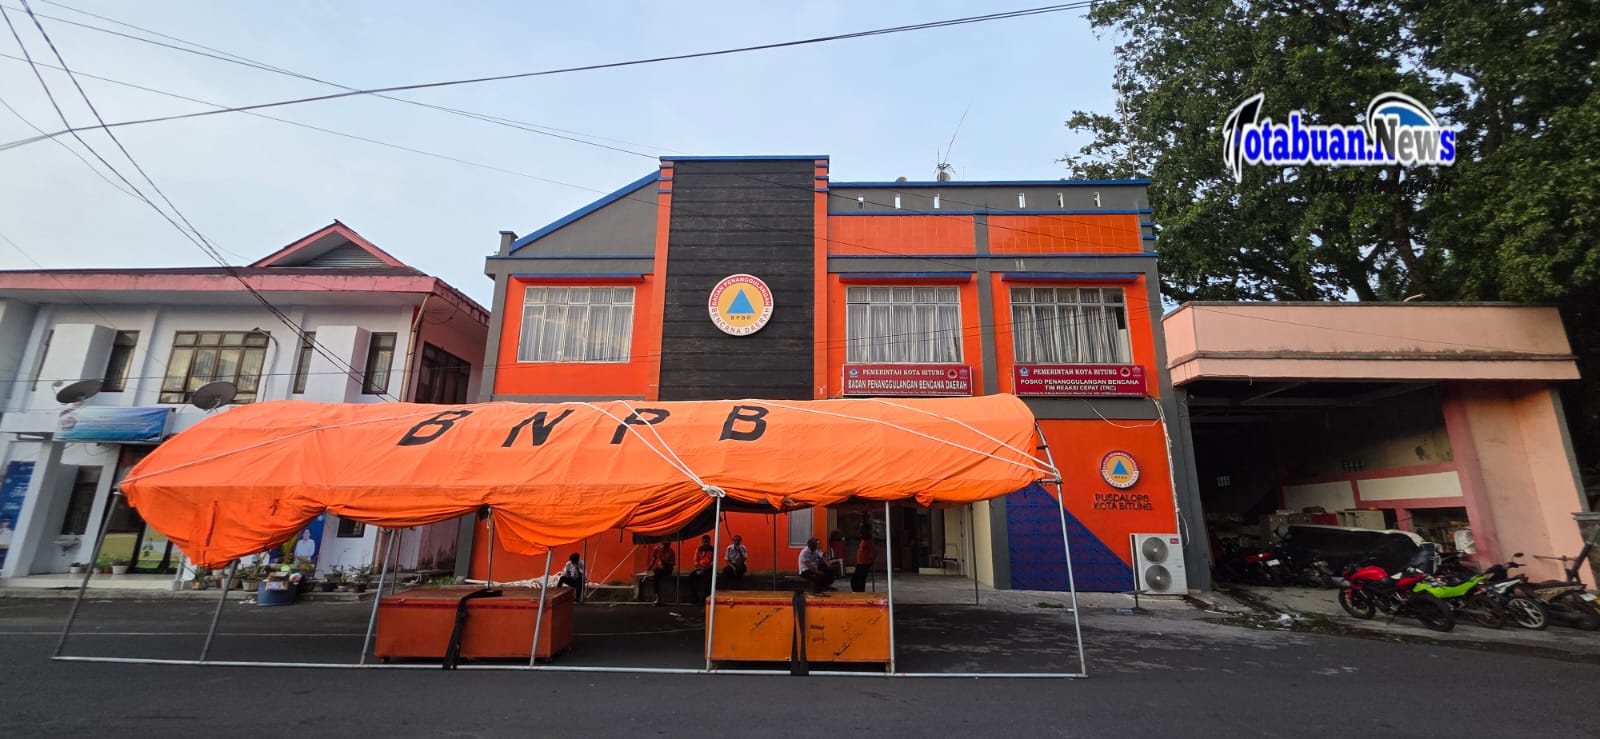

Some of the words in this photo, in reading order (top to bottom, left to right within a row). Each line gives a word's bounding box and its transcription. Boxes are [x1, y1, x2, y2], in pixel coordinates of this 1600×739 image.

[712, 286, 724, 306] BADAN
[711, 307, 742, 334] BENCANA
[744, 307, 771, 334] DAERAH
[848, 379, 867, 389] BADAN
[867, 379, 918, 389] PENANGGULANGAN
[919, 380, 945, 390] BENCANA
[945, 380, 967, 390] DAERAH
[1095, 494, 1149, 502] PUSDALOPS
[1093, 502, 1118, 510] KOTA
[1119, 502, 1153, 511] BITUNG
